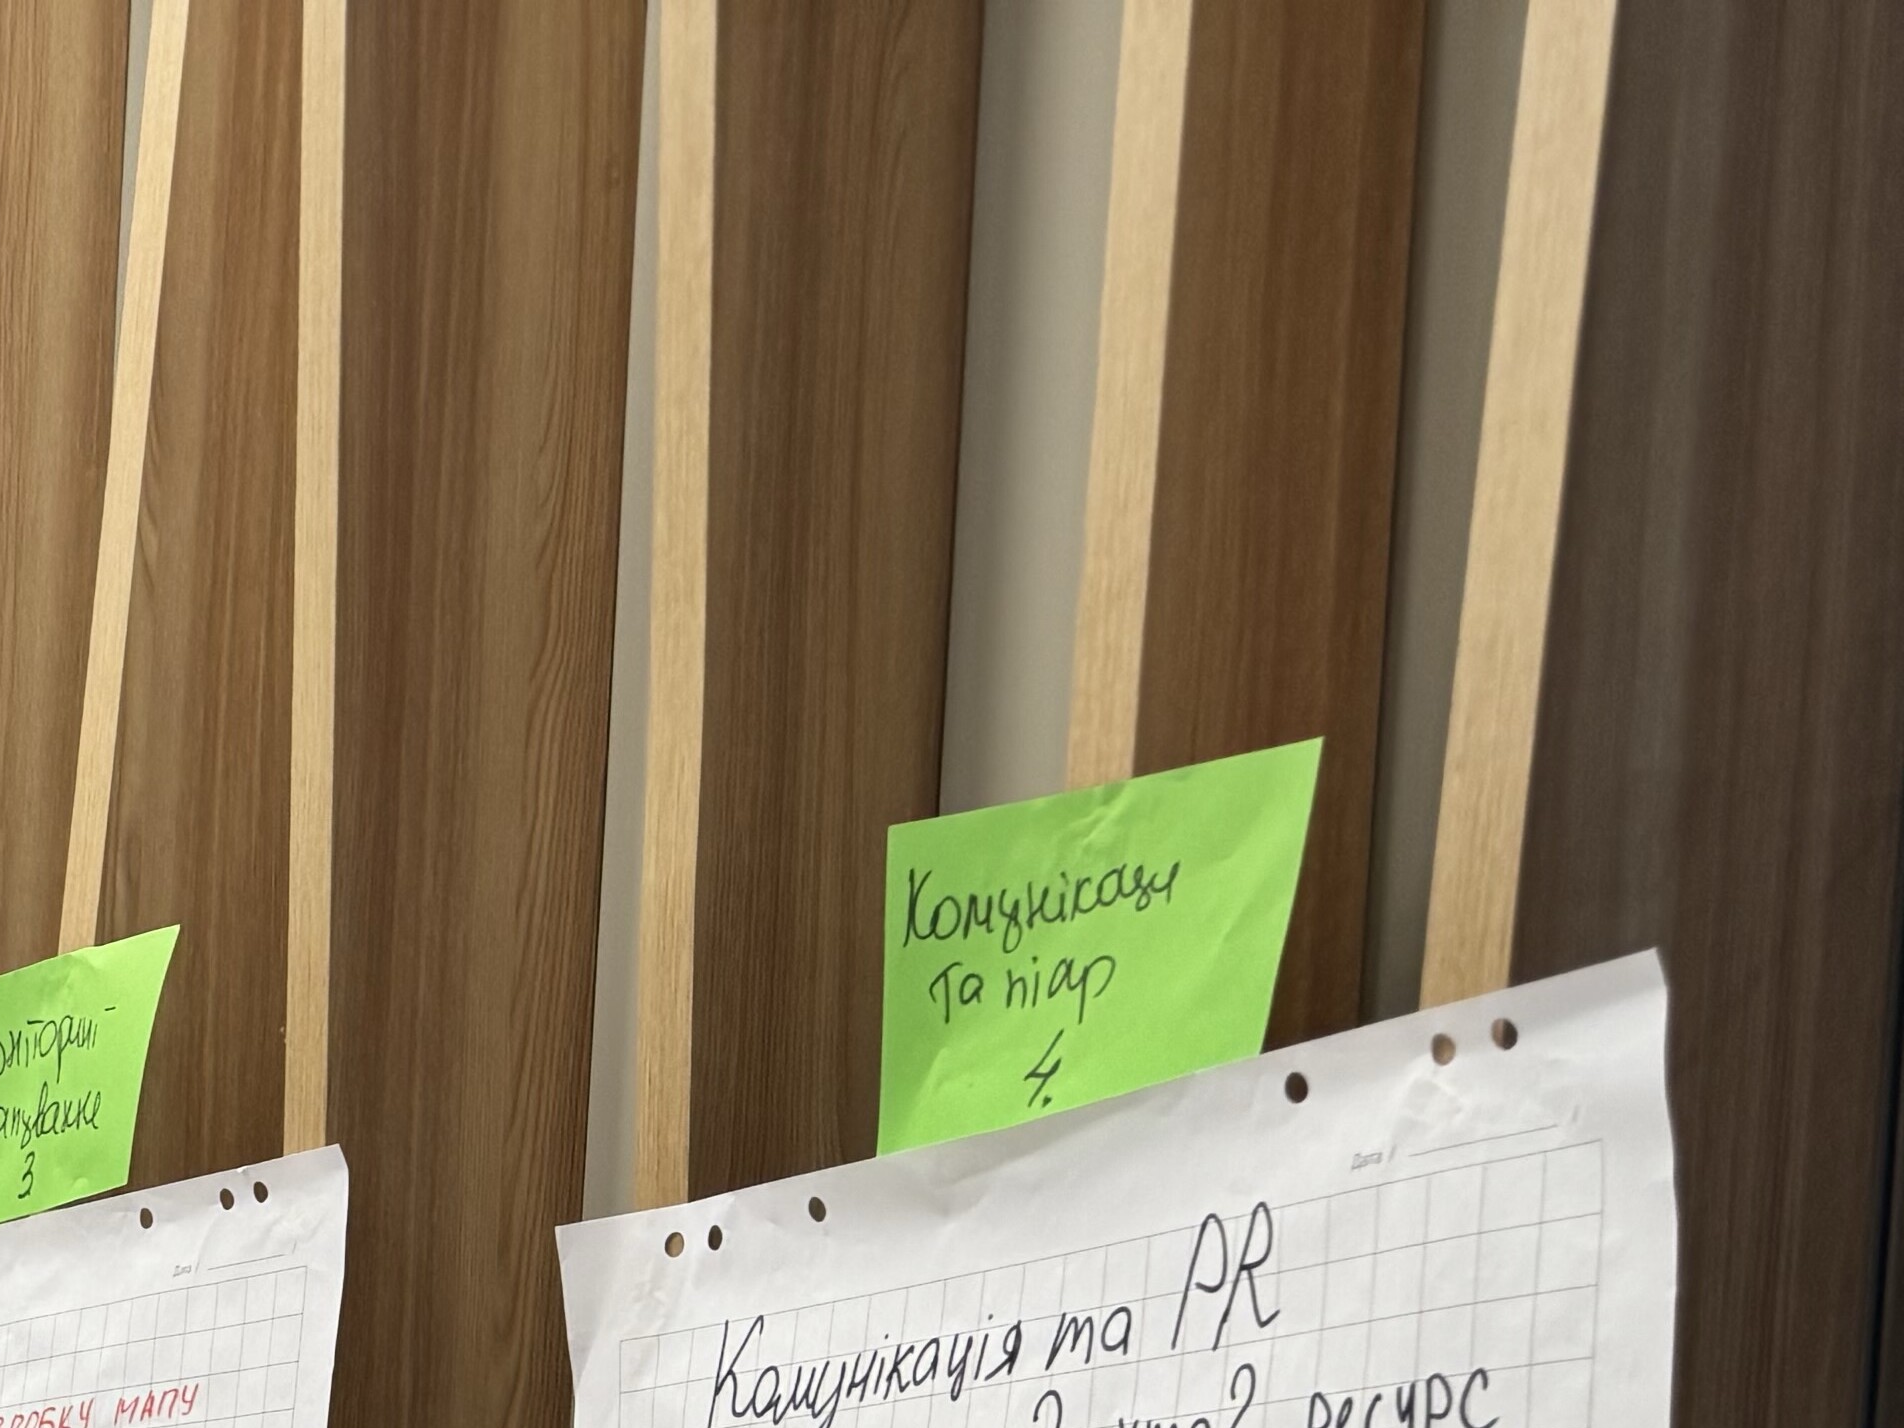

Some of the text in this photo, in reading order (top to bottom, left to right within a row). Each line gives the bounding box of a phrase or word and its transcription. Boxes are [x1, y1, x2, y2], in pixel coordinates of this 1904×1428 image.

[1005, 955, 1117, 1026] піар
[17, 1150, 36, 1200] 3
[113, 1382, 201, 1424] МАПУ
